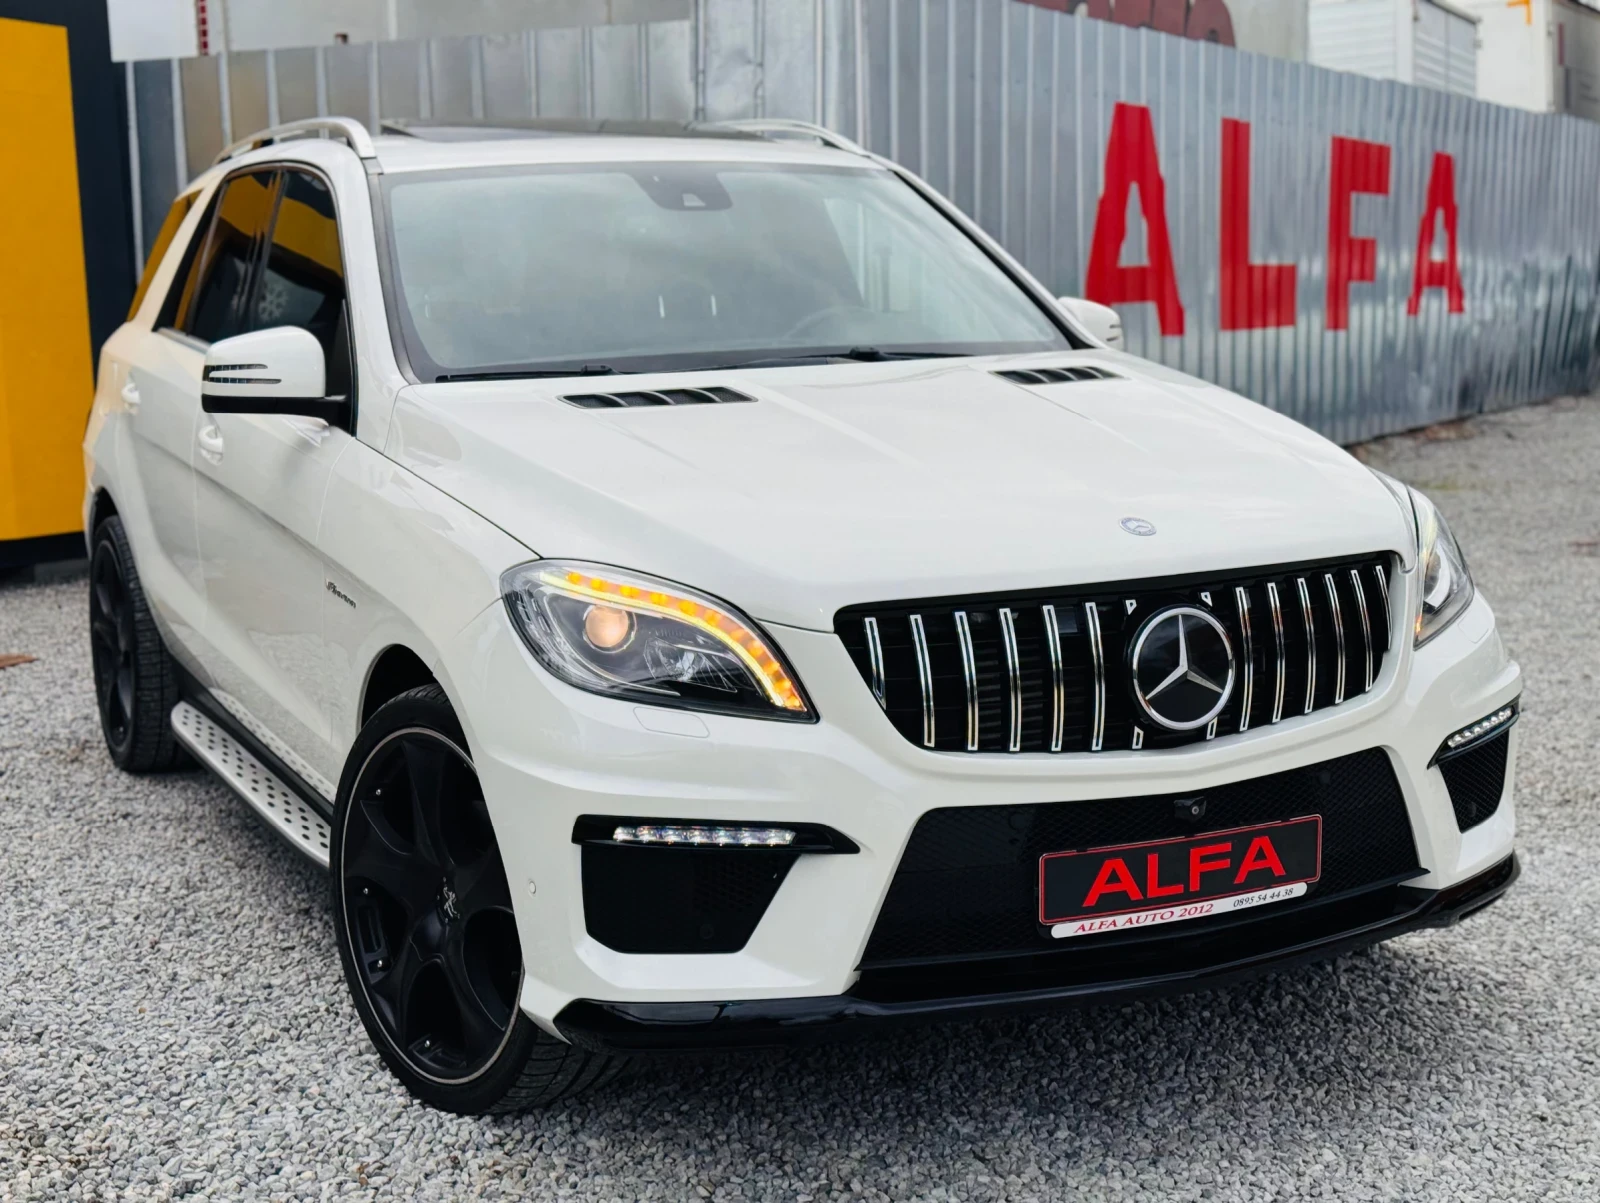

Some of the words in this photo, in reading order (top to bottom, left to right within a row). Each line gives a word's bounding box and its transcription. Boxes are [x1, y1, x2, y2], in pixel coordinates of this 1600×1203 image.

[1085, 101, 1464, 337] ALFA
[1082, 836, 1286, 907] ALFA
[1073, 919, 1118, 933] ALFA
[1121, 911, 1175, 926] AUTO
[1178, 903, 1214, 917] 2012
[1233, 896, 1255, 908] 0895
[1256, 893, 1267, 902] 54
[1269, 891, 1281, 899] 44
[1283, 888, 1294, 897] 38
